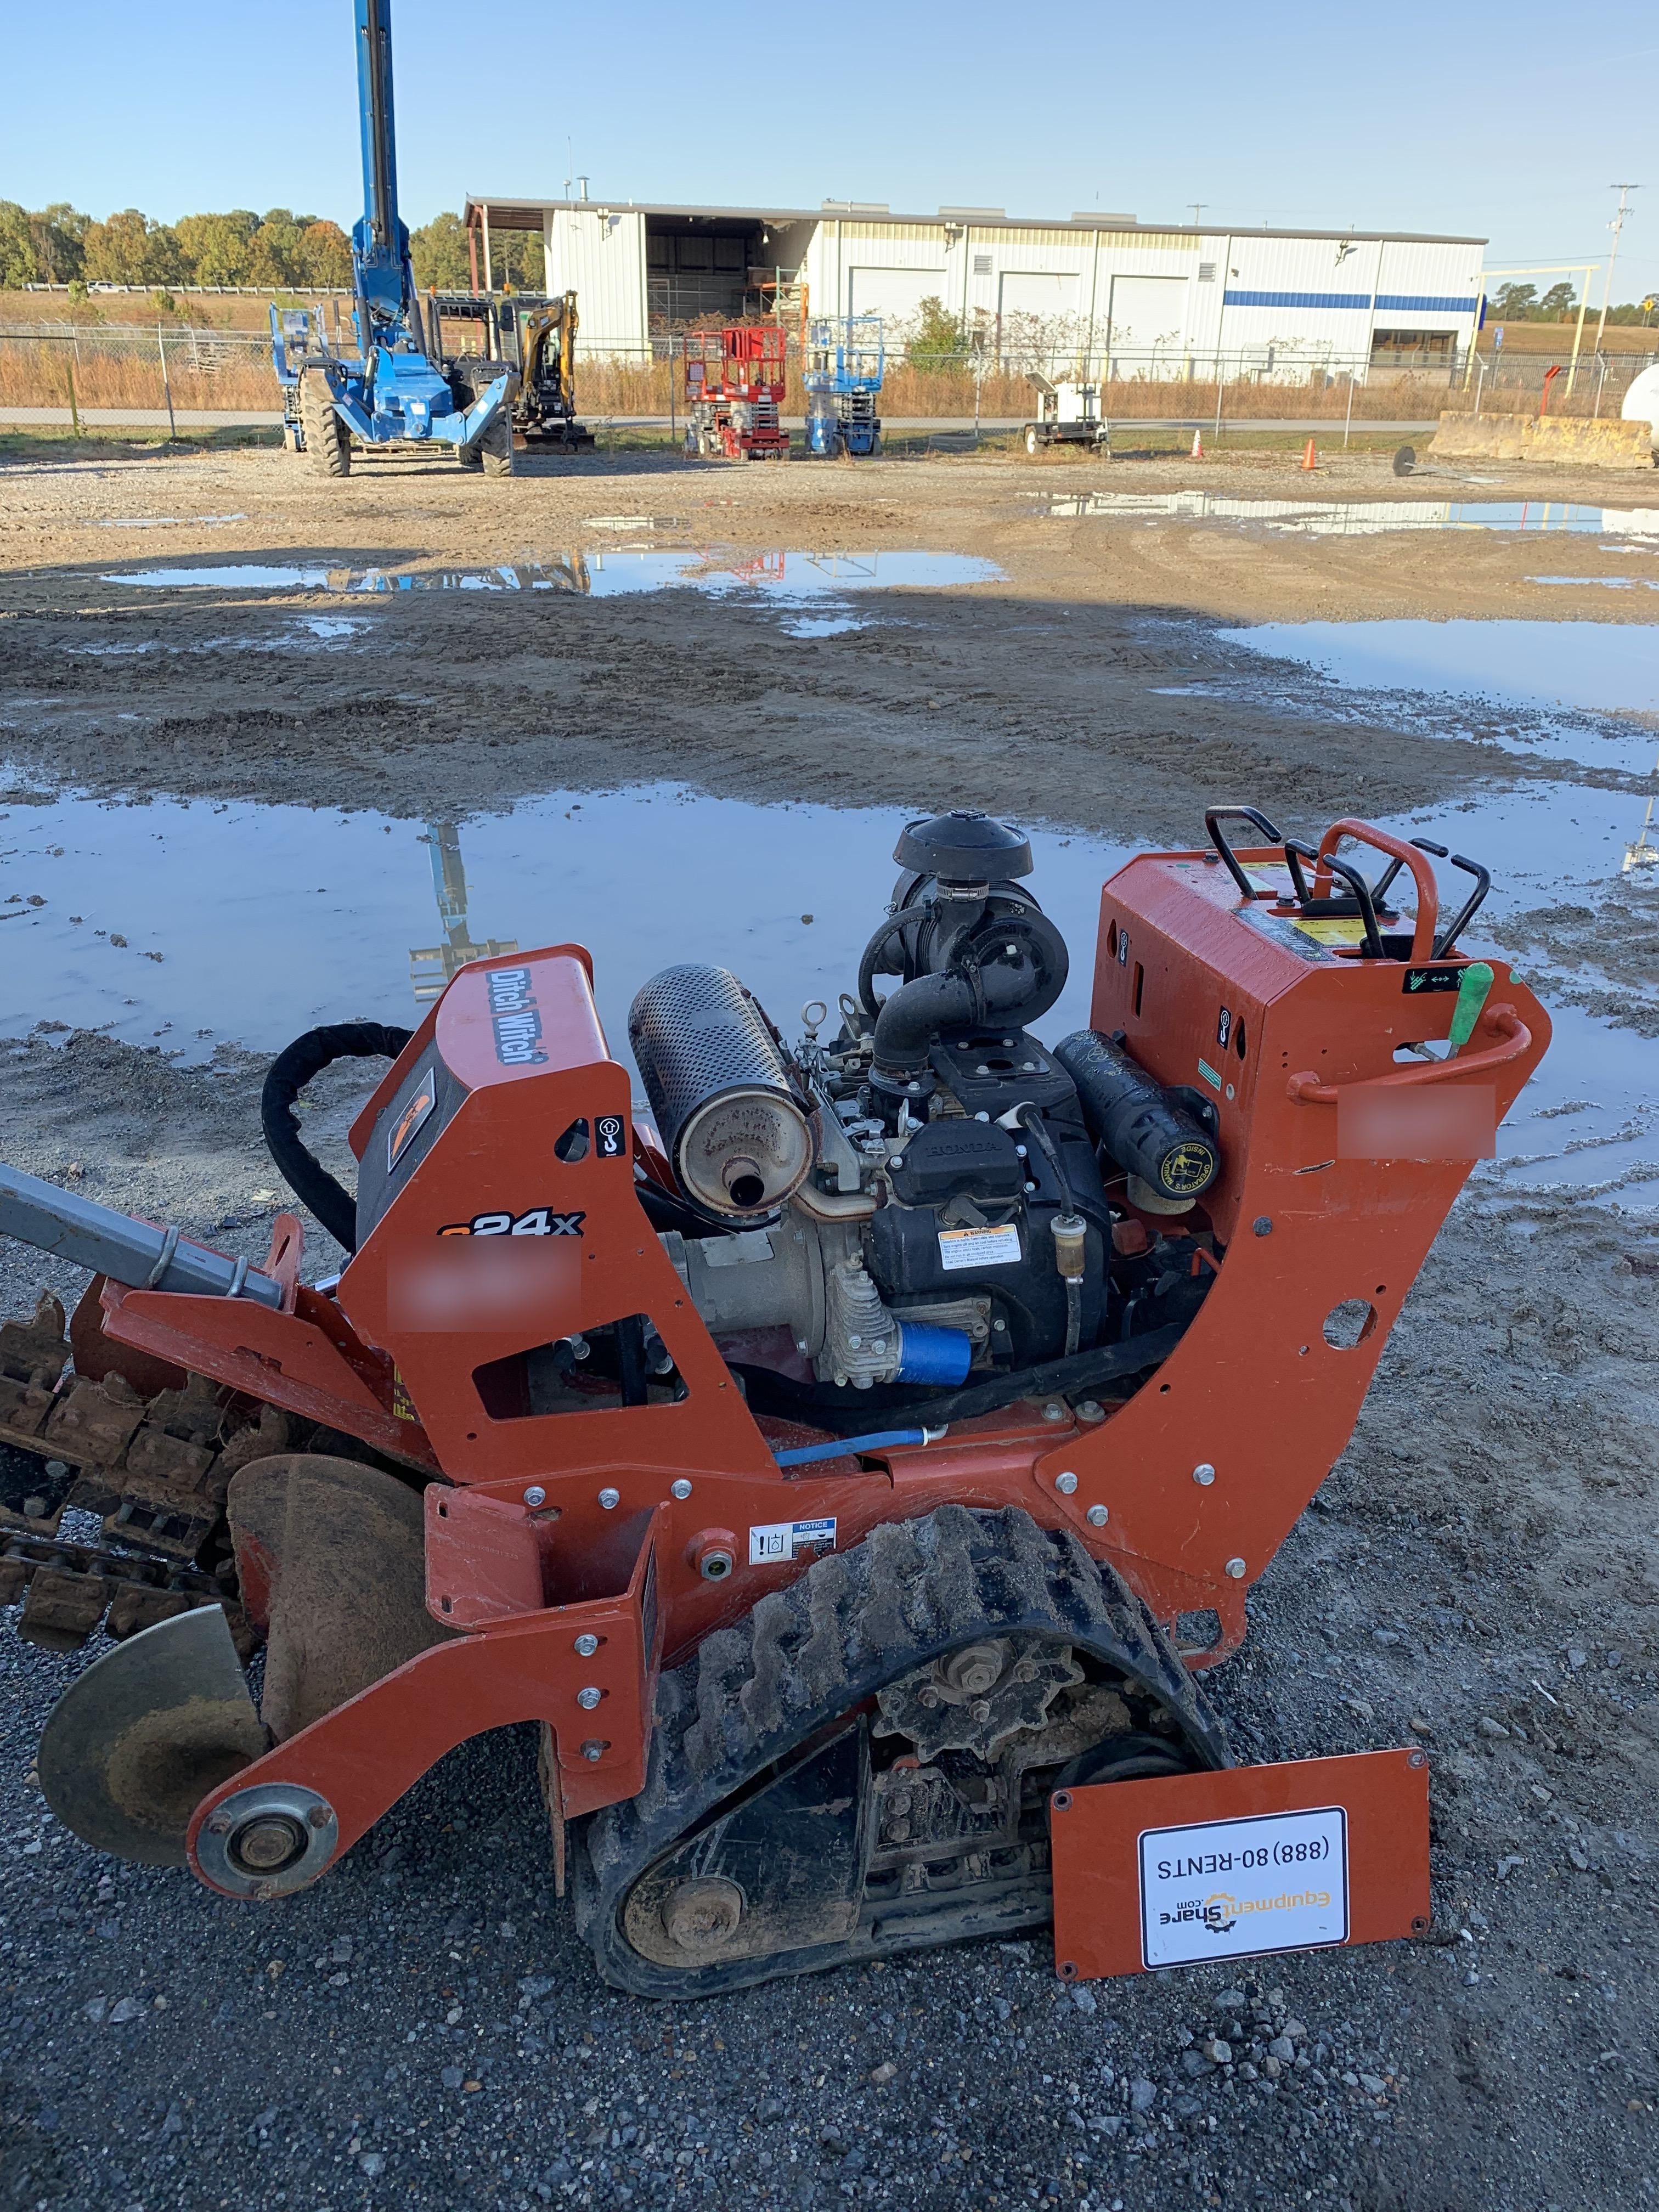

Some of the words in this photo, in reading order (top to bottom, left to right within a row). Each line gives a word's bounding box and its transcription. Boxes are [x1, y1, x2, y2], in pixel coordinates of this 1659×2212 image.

[490, 969, 529, 1012] Ditch
[497, 1012, 537, 1063] Witch
[926, 1142, 1003, 1157] HONDA
[1181, 1146, 1206, 1156] INSIDE
[1175, 1164, 1210, 1190] OPERATOR'S
[799, 1521, 828, 1530] NOTICE
[1158, 1848, 1268, 1880] 80-RENTS
[1273, 1835, 1329, 1866] (888)
[1159, 1891, 1331, 1925] EquipmentShare
[1176, 1899, 1204, 1910] .com
